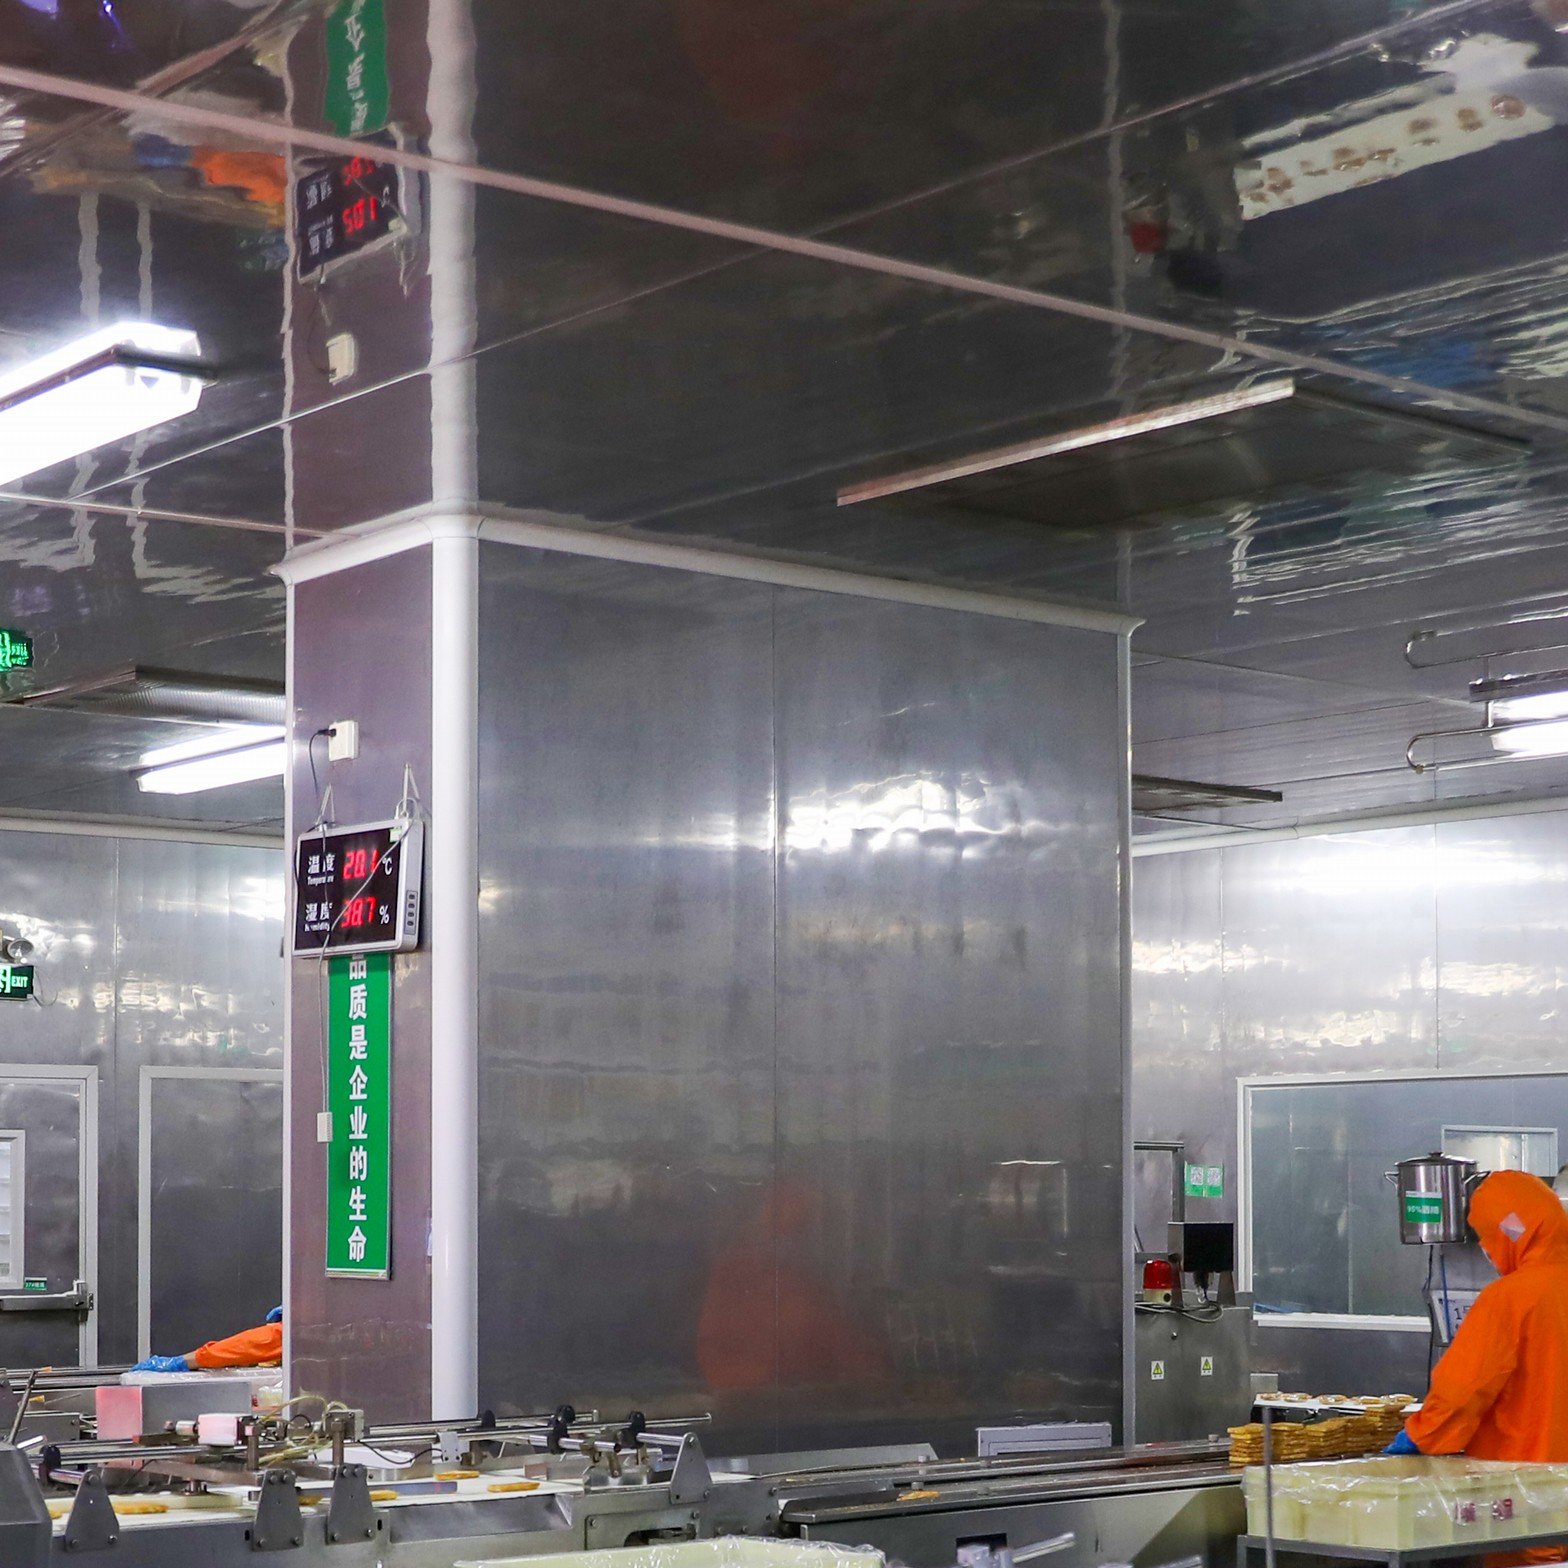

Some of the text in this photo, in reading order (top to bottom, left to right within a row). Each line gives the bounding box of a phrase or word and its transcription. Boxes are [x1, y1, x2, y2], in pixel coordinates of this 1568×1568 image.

[12, 976, 28, 988] EXIT
[348, 954, 368, 1263] 品质是企业的生命
